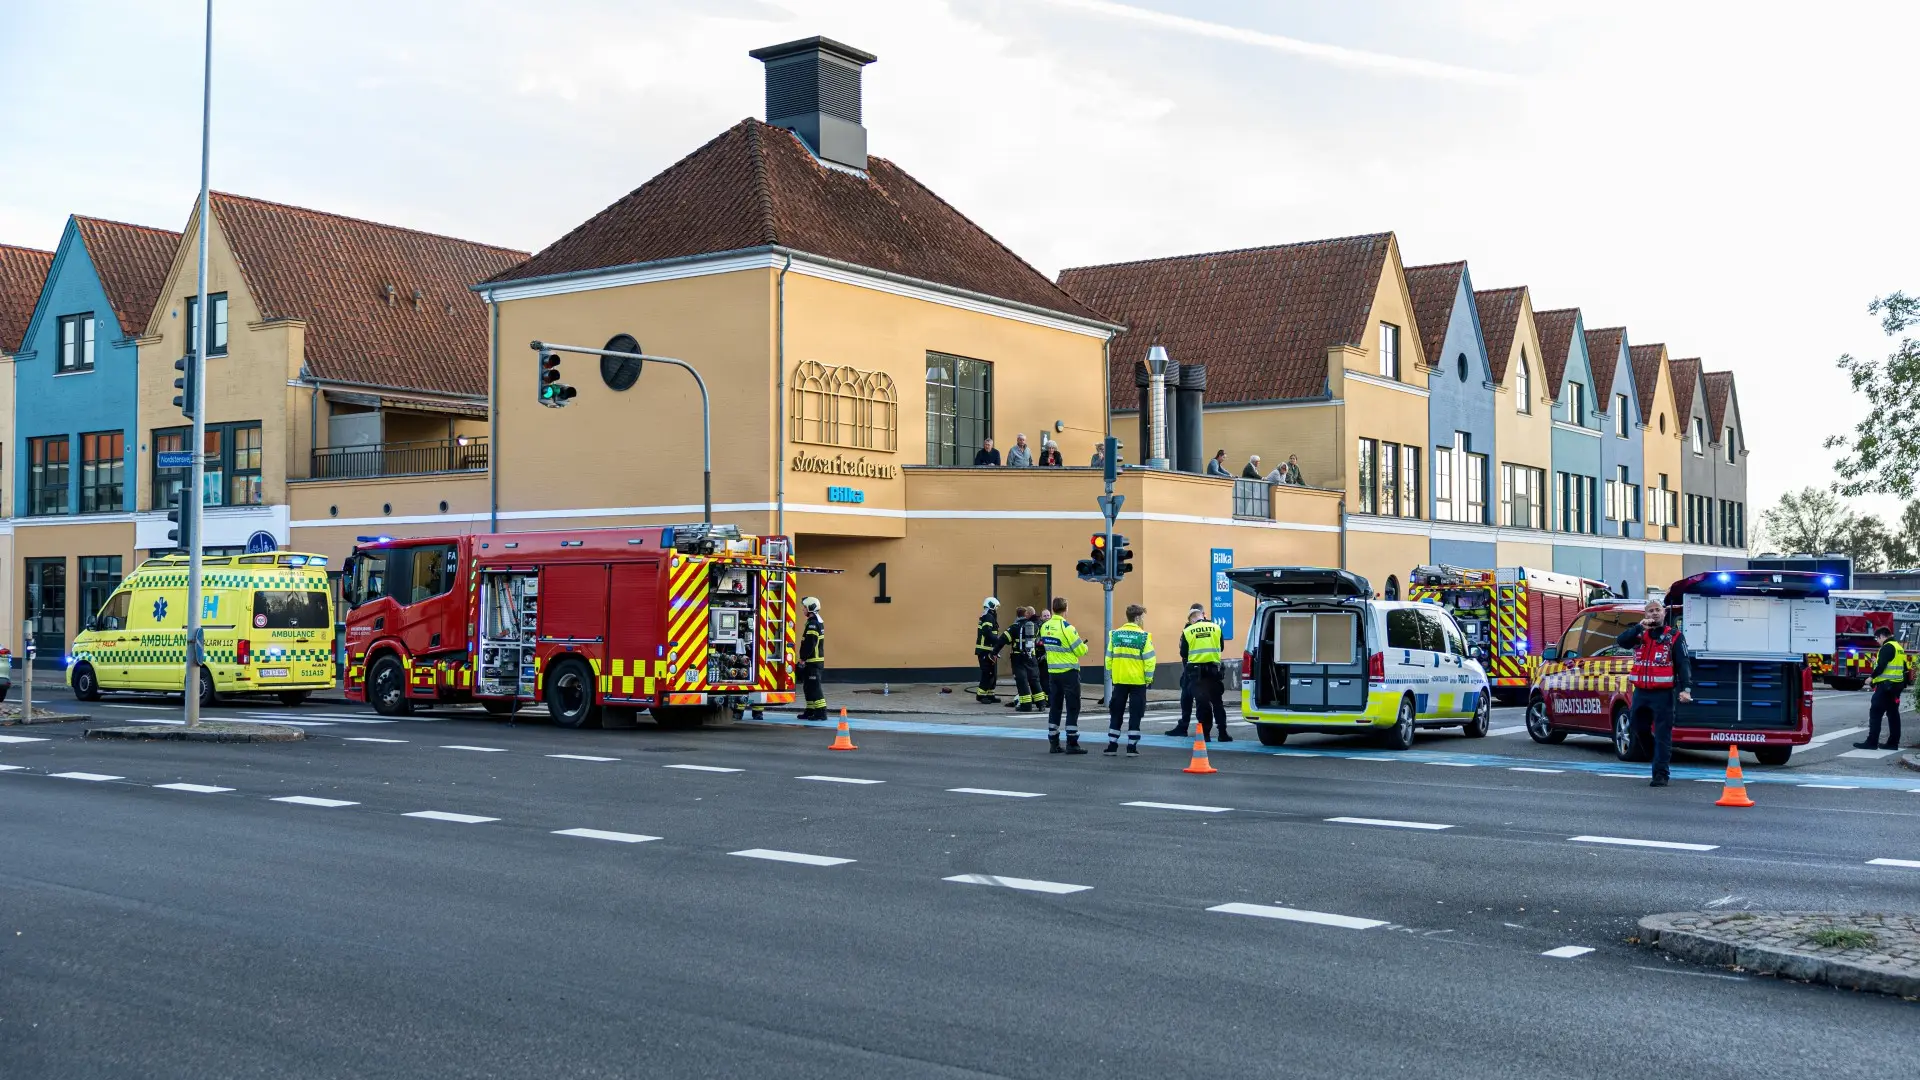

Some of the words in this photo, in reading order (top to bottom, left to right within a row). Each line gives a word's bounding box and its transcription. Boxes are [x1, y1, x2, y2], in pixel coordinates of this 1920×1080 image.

[792, 451, 897, 479] slotsarkaderne
[828, 486, 864, 503] Bilka
[447, 552, 456, 560] FA
[1213, 552, 1232, 564] Bilka
[447, 565, 456, 573] M1
[869, 562, 891, 604] 1
[271, 630, 316, 638] AMBULANCE
[1190, 626, 1216, 635] POLITI
[140, 634, 188, 647] AMBULAN
[223, 639, 234, 647] 112
[301, 669, 325, 677] 511A19
[1554, 698, 1602, 714] INDSATSLEDER
[1710, 732, 1766, 743] INDSATSLEDER
